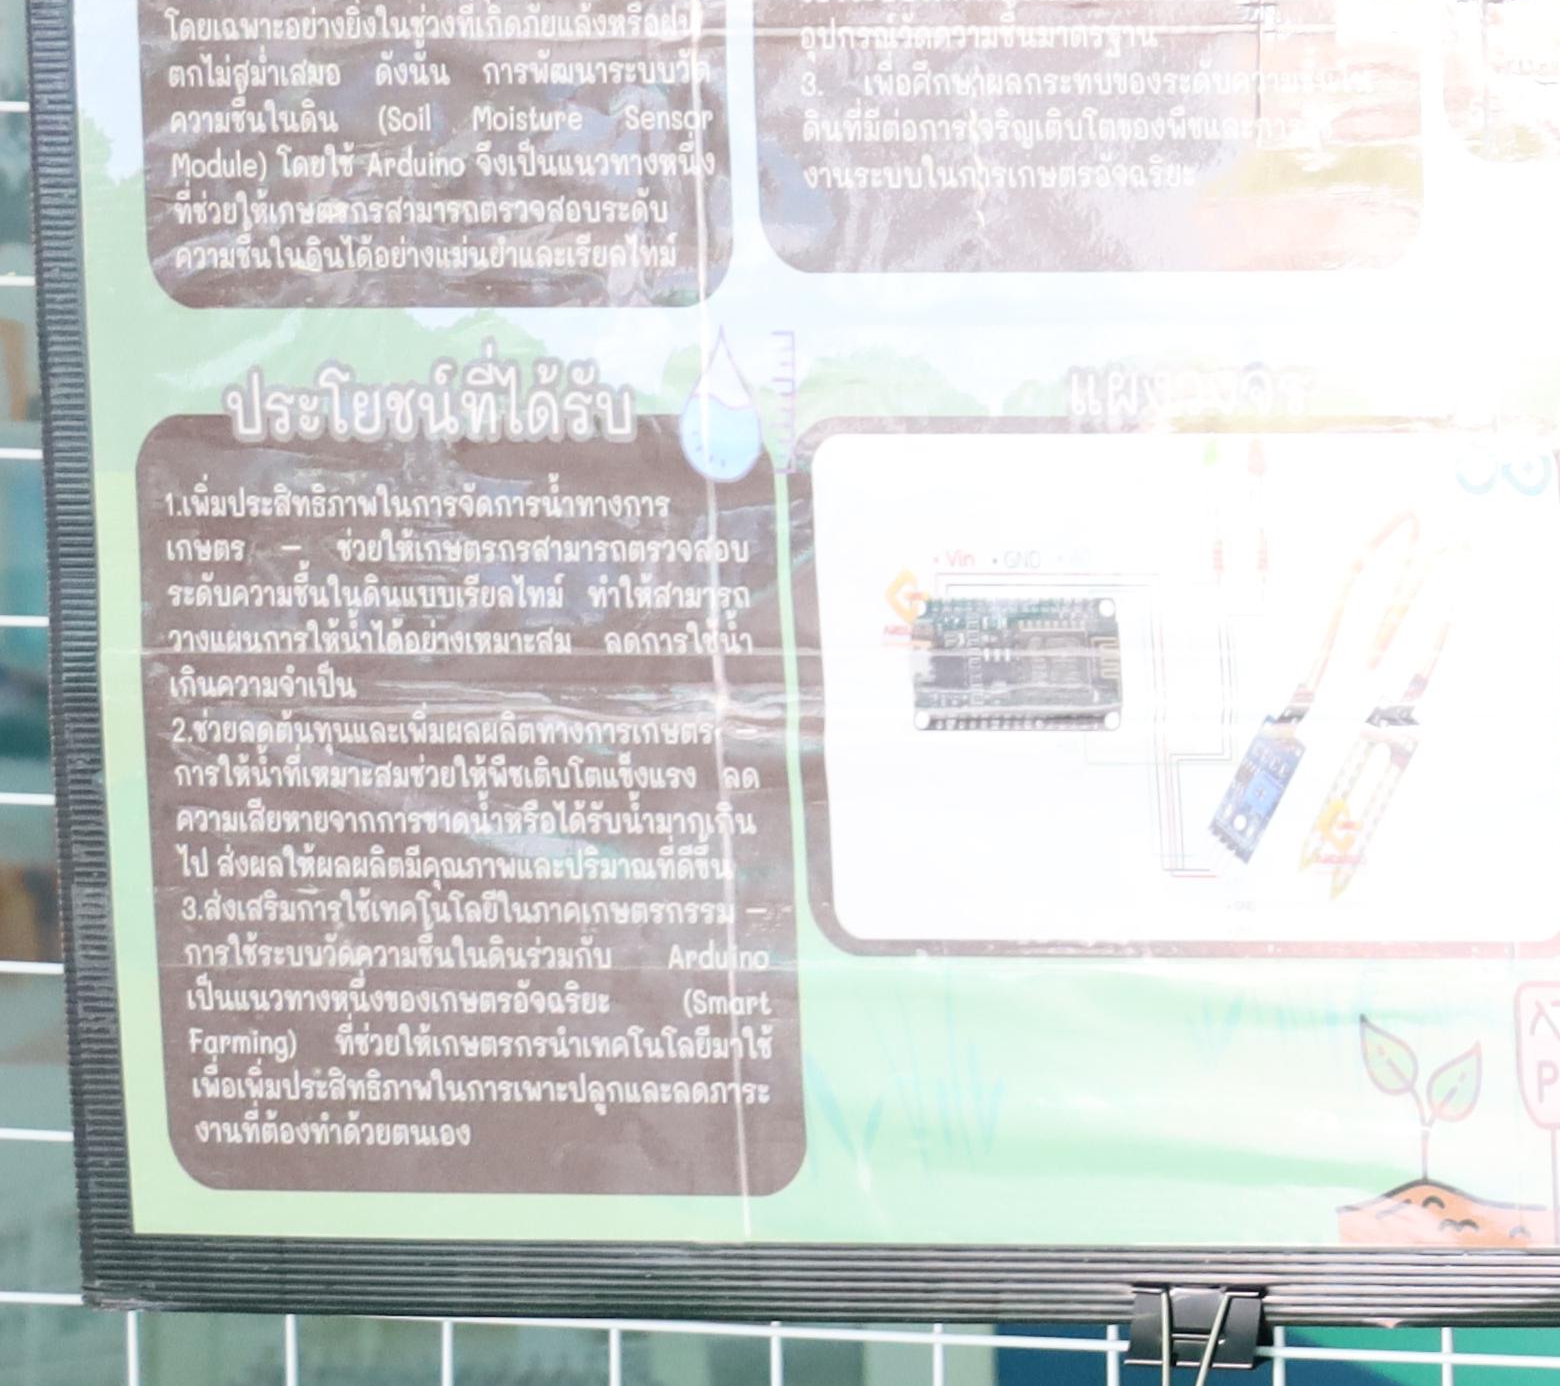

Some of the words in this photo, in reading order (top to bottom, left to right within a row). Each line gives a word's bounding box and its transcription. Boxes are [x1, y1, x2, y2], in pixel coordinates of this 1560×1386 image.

[377, 102, 433, 136] (Soil
[472, 105, 584, 133] Moisture
[624, 107, 714, 132] Sensor
[171, 151, 268, 183] Module)
[278, 140, 356, 180] โดยใช้
[367, 151, 466, 179] Arduino
[222, 330, 640, 443] ประโยชน์ที่ได้รับ
[166, 541, 246, 566] เกษตร
[170, 659, 357, 701] เกินความจำเป็น
[176, 843, 209, 878] ไป
[668, 943, 770, 970] Arduino
[683, 989, 773, 1018] (Smart
[189, 1029, 297, 1065] Farming)
